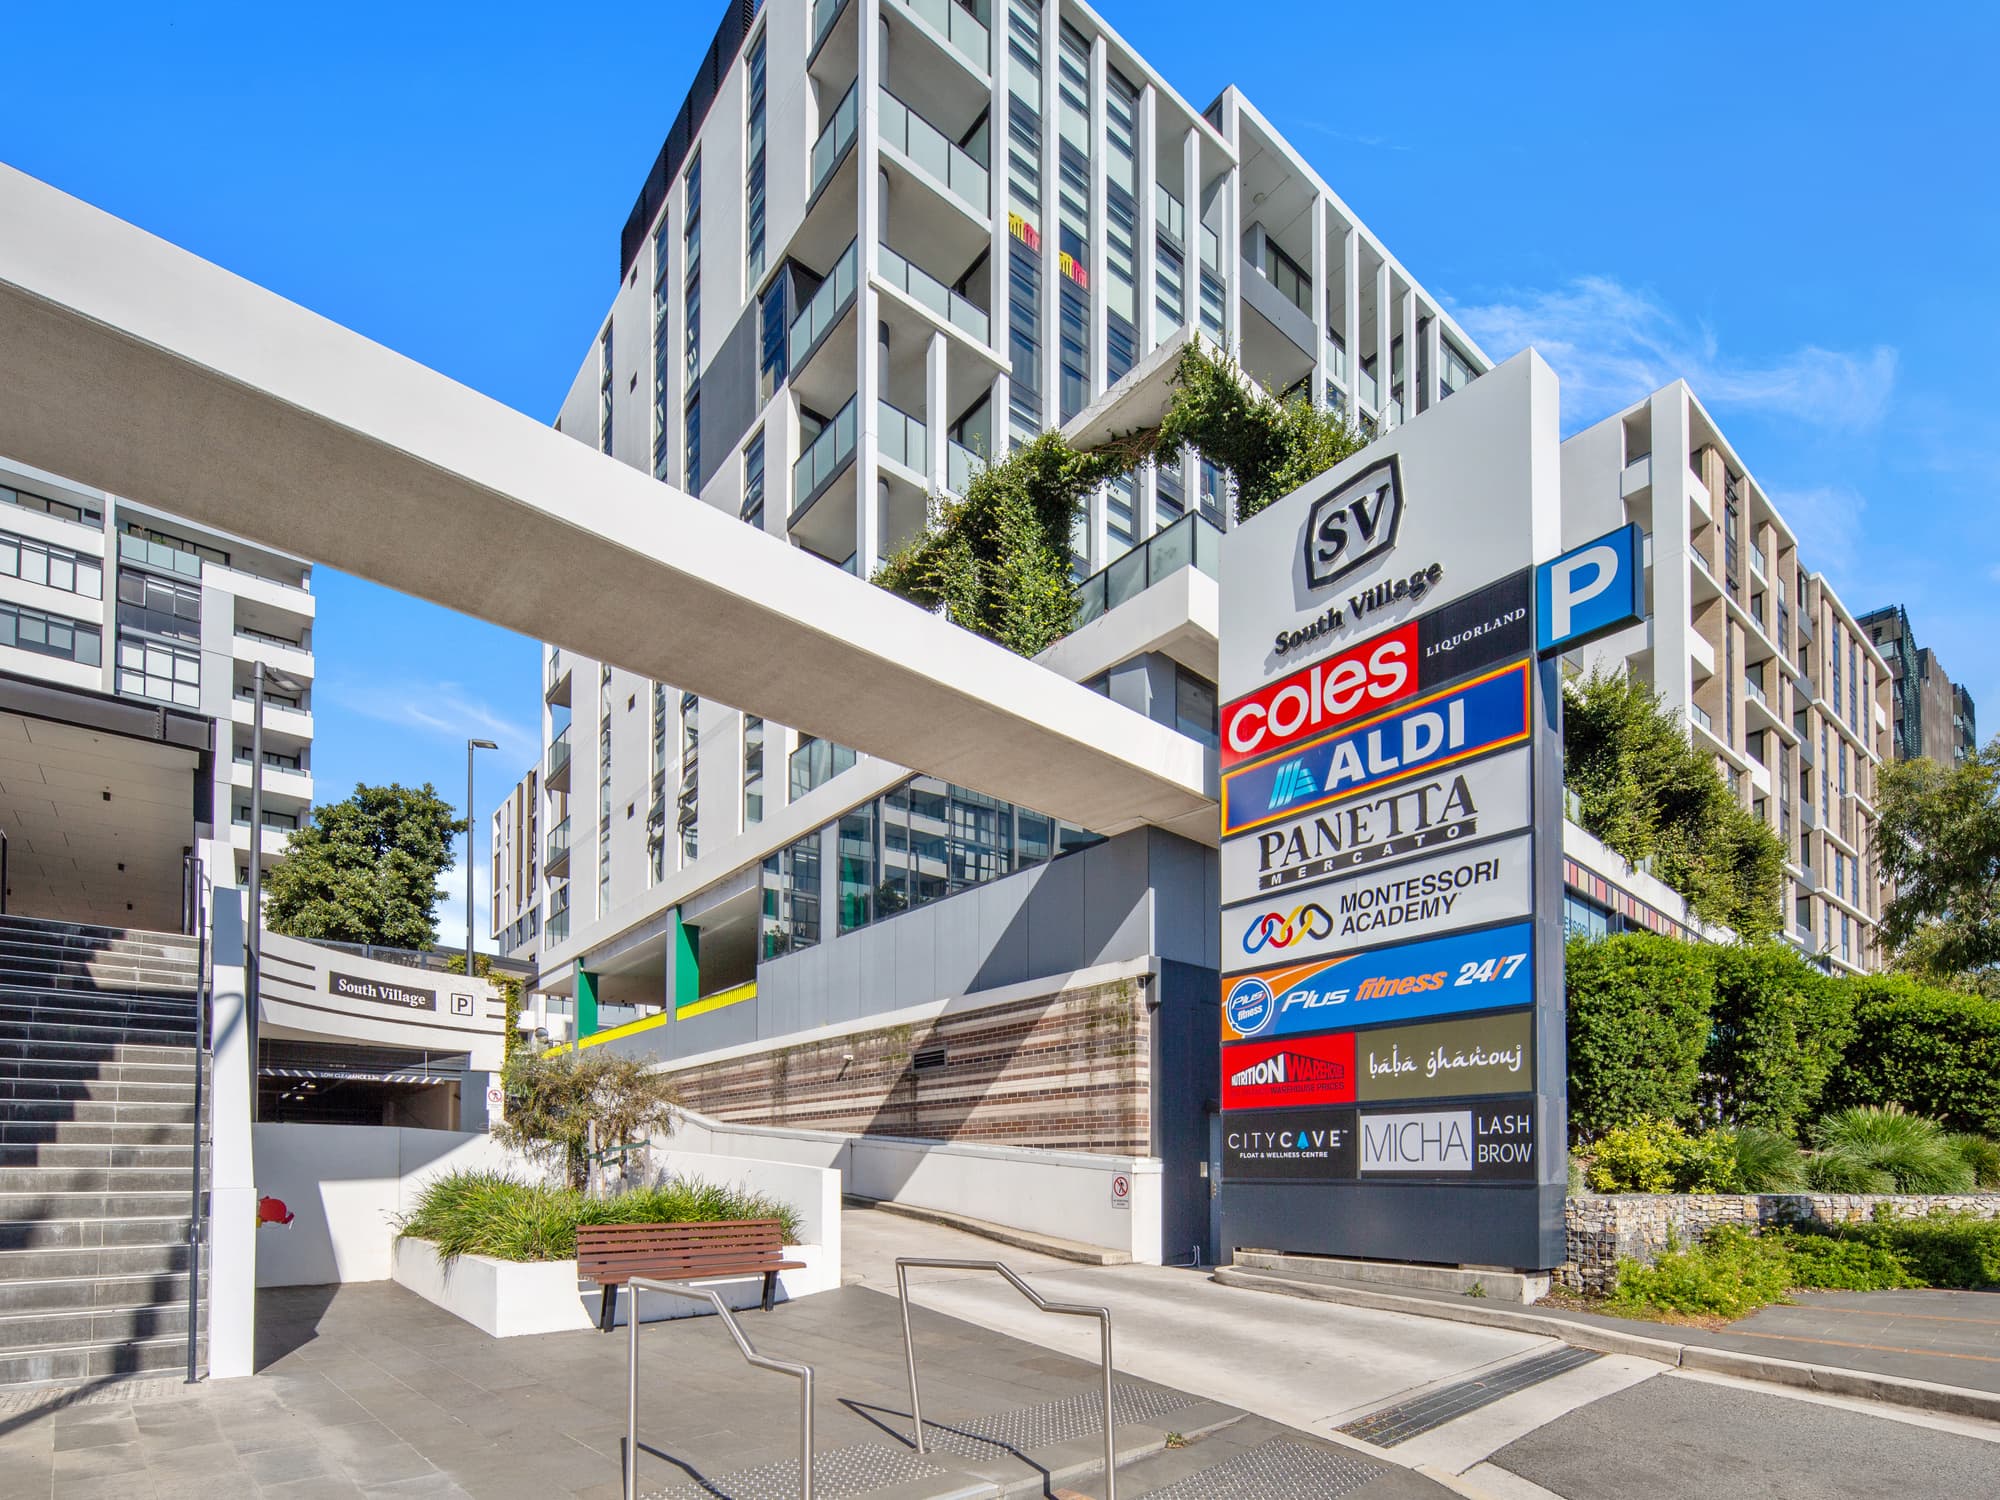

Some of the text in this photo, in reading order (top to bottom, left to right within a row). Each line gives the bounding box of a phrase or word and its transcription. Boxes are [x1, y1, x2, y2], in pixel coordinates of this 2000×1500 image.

[1318, 482, 1390, 564] SV
[1275, 562, 1444, 656] South Village
[1551, 545, 1619, 641] P
[1426, 607, 1527, 658] LIQUORLAND
[1228, 640, 1409, 753] coles
[1324, 698, 1465, 792] ALDI
[1257, 773, 1479, 872] PANETTA
[1270, 825, 1460, 886] MERCATO
[1340, 858, 1499, 915] MONTESSORI
[1340, 892, 1458, 936] ACADEMY
[338, 978, 426, 1007] South Village
[1354, 970, 1448, 1002] fitness
[1454, 953, 1527, 987] 24/7
[456, 997, 468, 1012] P
[1231, 1053, 1284, 1087] NUTRITION
[1365, 1121, 1468, 1162] MICHA
[1478, 1114, 1530, 1135] LASH
[1239, 1151, 1260, 1159] FLOAT
[1266, 1151, 1301, 1159] WELLNESS
[1478, 1143, 1532, 1163] BROW
